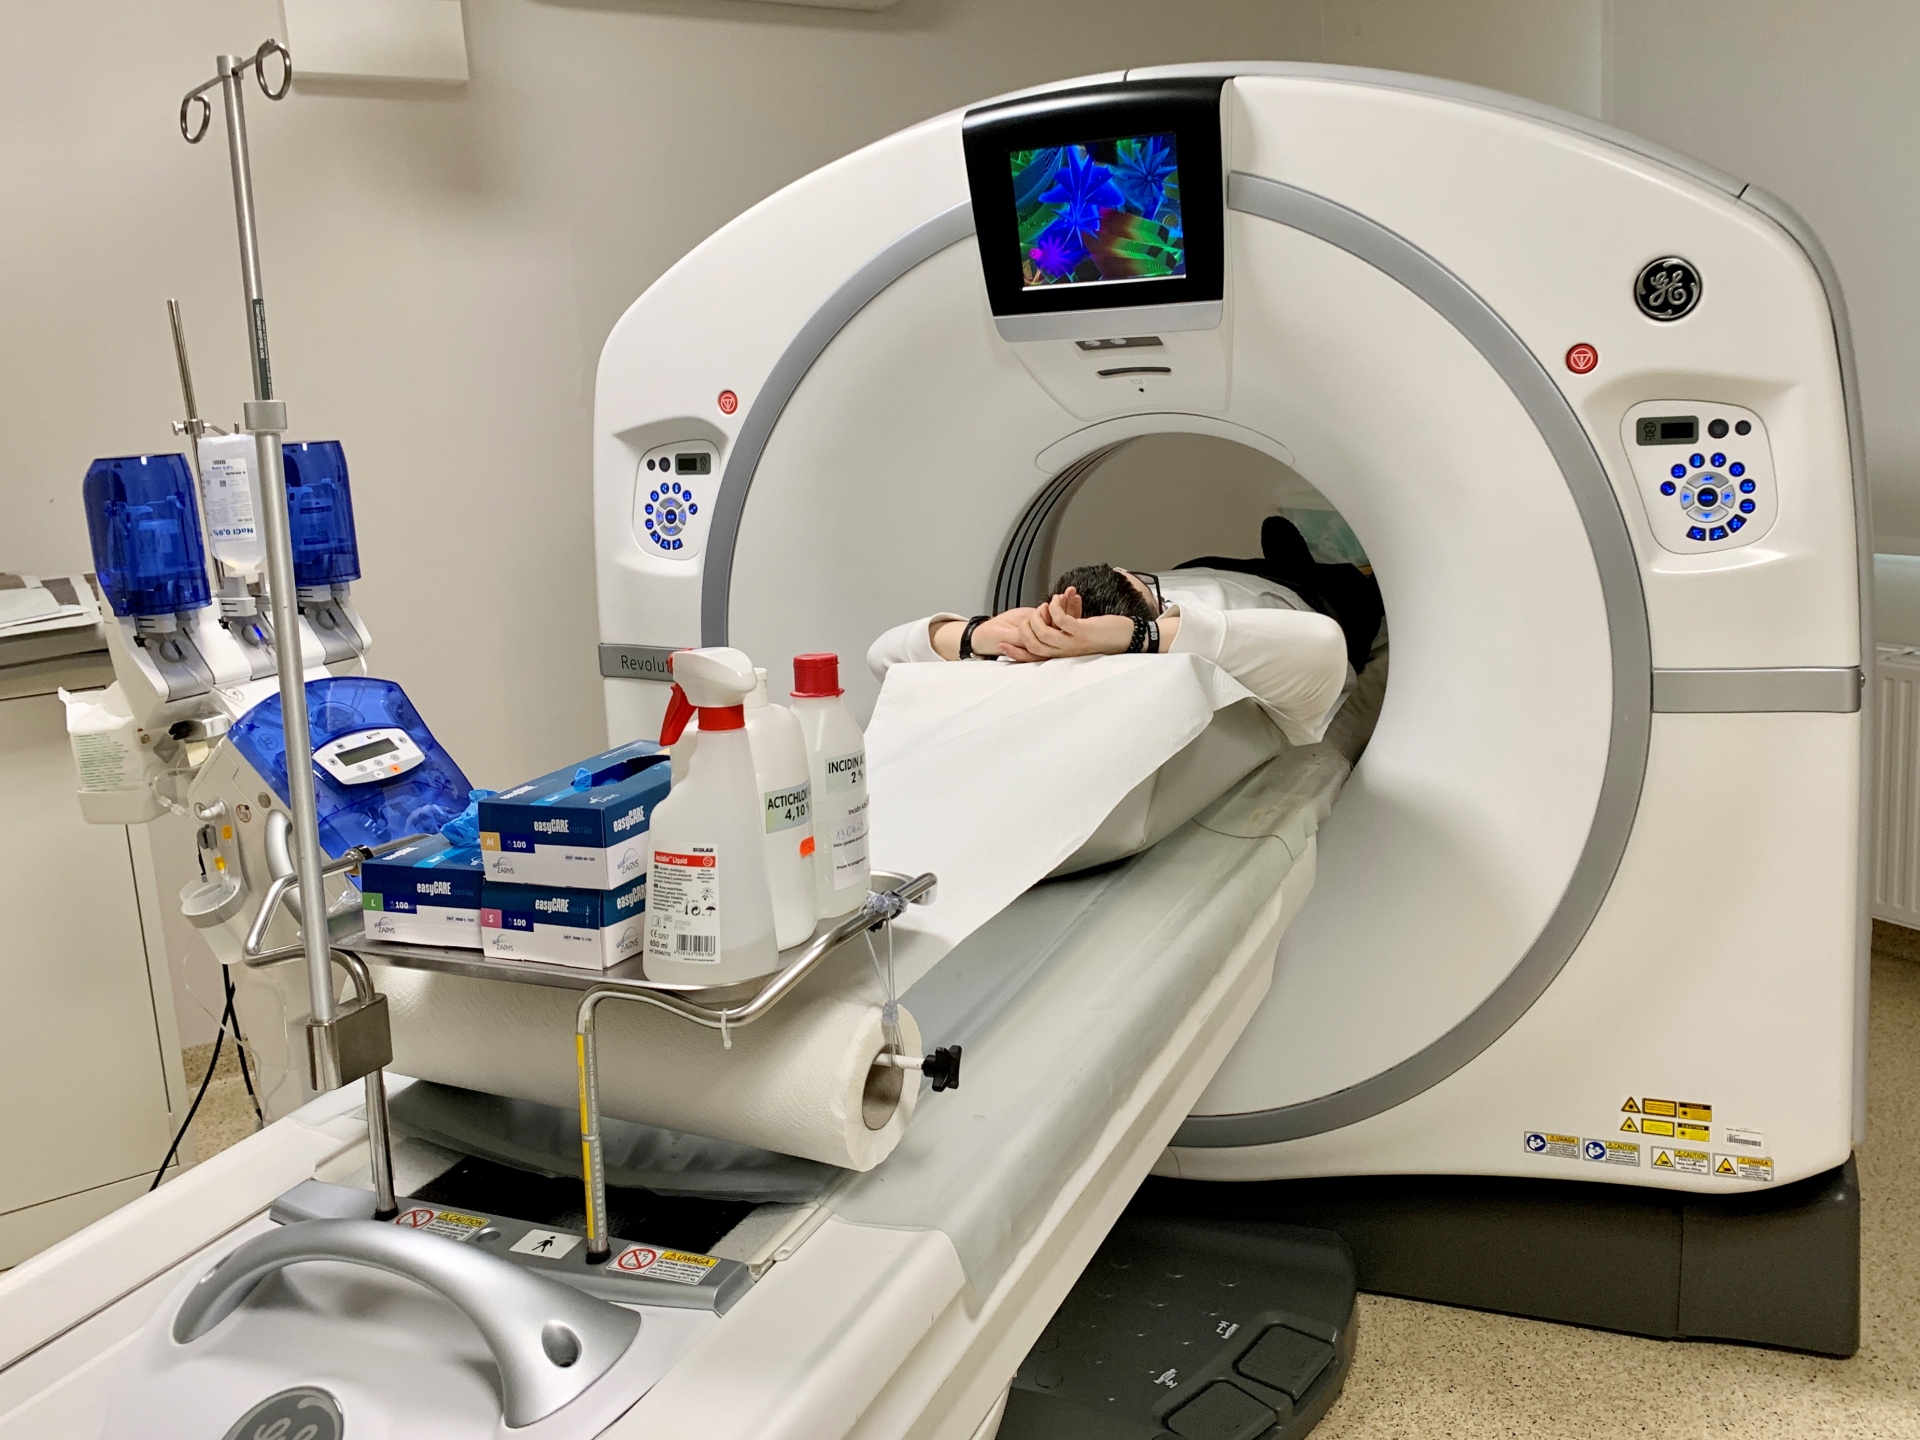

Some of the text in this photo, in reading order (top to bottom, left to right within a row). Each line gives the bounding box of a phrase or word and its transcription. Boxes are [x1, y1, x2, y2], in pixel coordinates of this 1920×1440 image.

[828, 756, 858, 774] INCIDIN
[851, 772, 856, 784] 2
[613, 805, 645, 832] easyCARE
[785, 804, 805, 821] 4,10
[534, 819, 569, 834] easyCARE
[622, 859, 639, 874] ZARYS
[673, 856, 688, 865] Liquid
[417, 881, 451, 896] easyCARE
[616, 882, 646, 909] easyCAR
[535, 898, 569, 913] easyCARE
[620, 938, 639, 953] ZARYS
[449, 1216, 482, 1226] CAUTION
[676, 1254, 710, 1265] UWAGA
